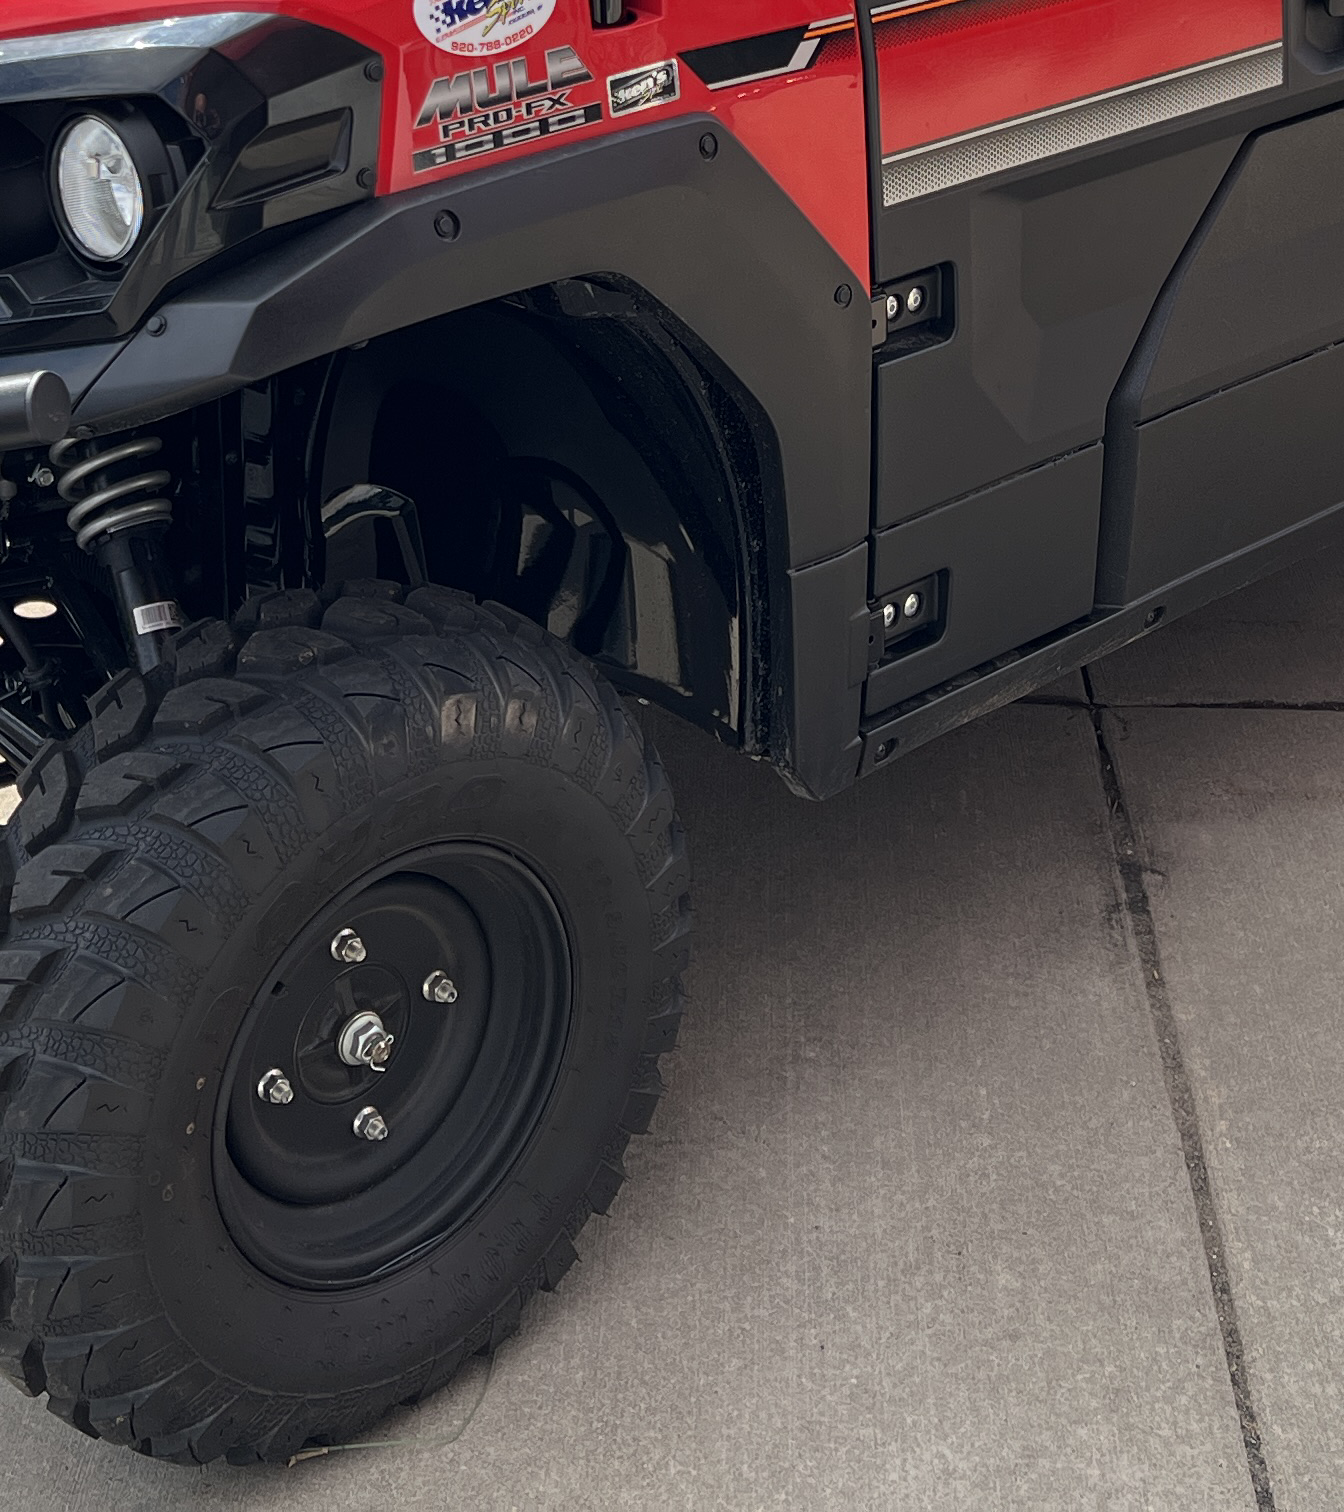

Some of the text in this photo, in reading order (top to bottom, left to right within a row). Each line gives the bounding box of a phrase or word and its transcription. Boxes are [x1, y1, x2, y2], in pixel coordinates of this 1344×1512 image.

[451, 25, 533, 52] 920-788-0220
[414, 44, 595, 129] MULE
[431, 109, 586, 164] 1000
[439, 90, 574, 142] PRO-FX
